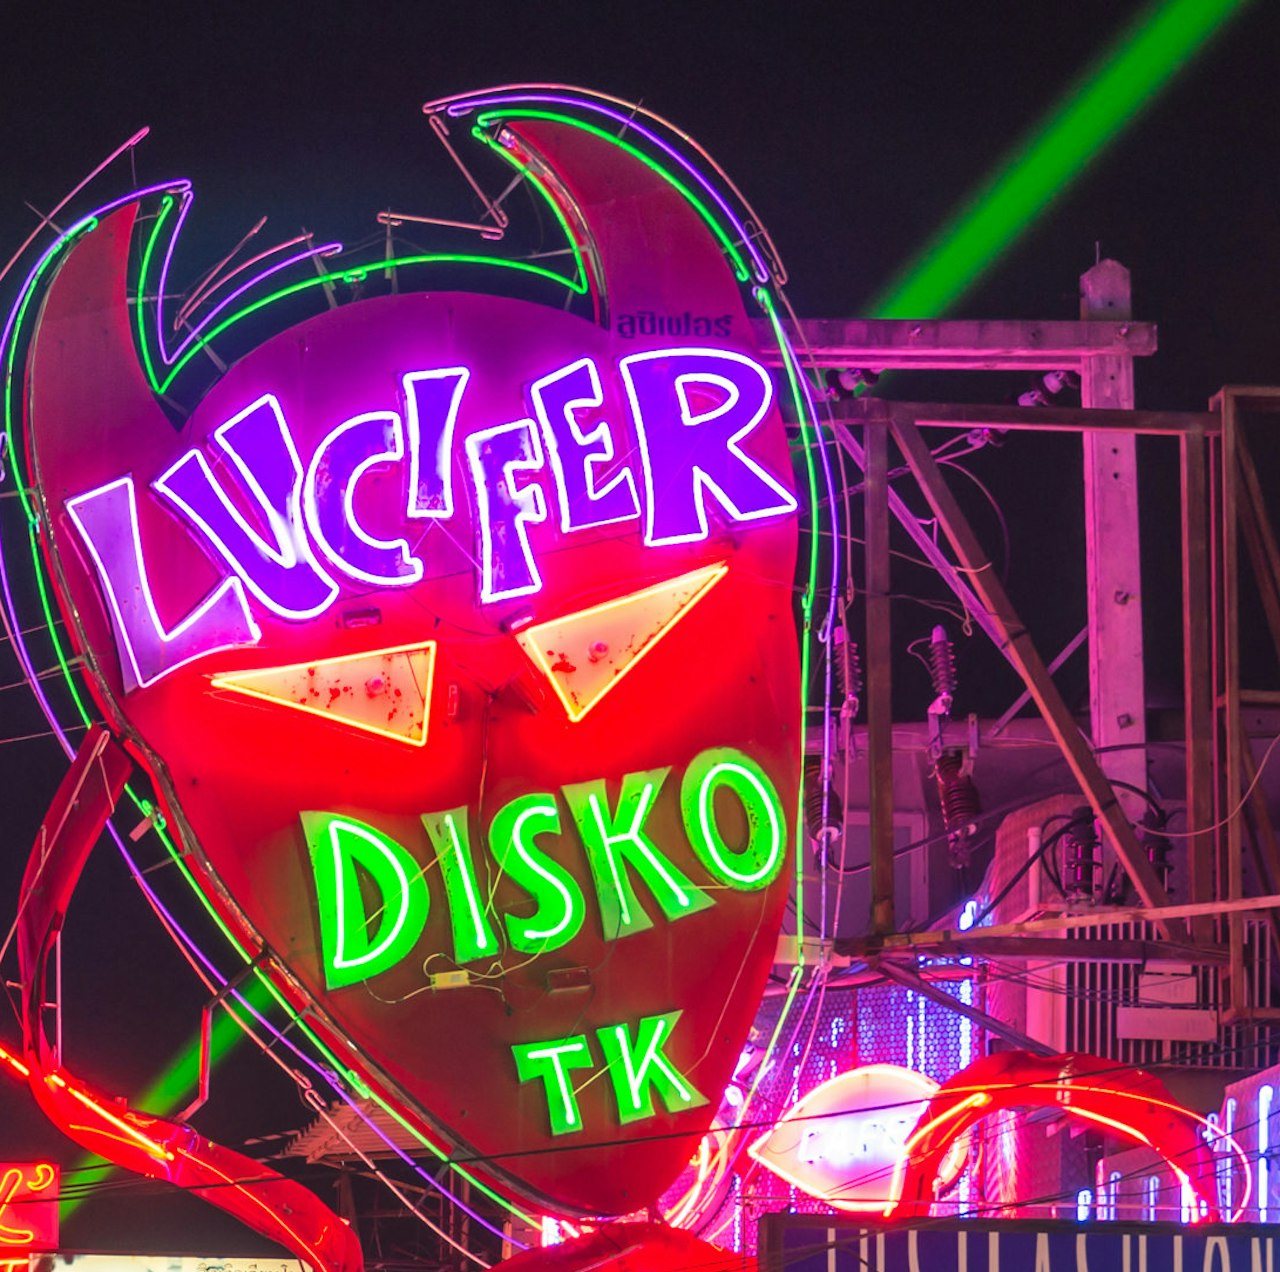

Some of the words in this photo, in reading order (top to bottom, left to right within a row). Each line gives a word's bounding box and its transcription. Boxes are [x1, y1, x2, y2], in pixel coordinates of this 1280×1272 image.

[64, 347, 799, 689] LUCIFER
[300, 747, 787, 990] DISKO
[510, 1009, 710, 1137] TK
